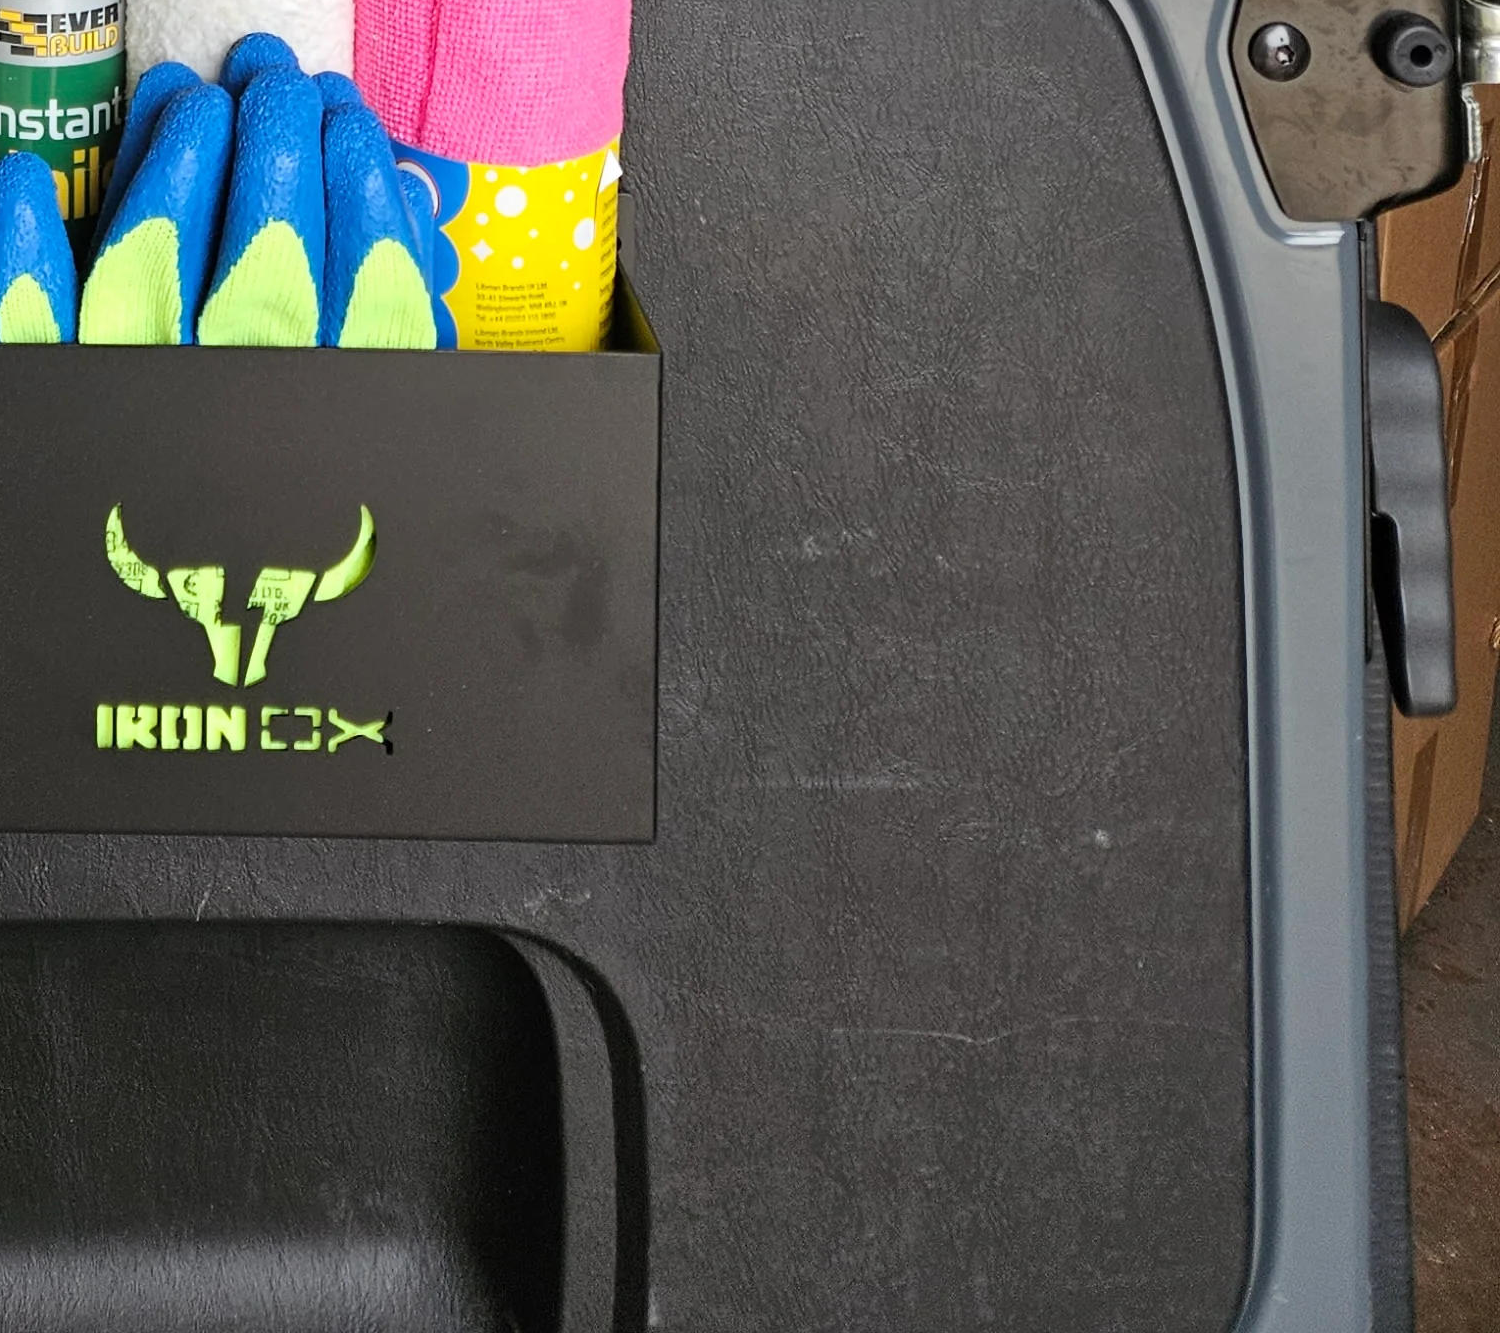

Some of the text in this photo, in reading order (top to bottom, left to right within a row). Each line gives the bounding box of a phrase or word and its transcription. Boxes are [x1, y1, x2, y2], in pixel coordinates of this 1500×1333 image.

[50, 2, 119, 34] EVER
[48, 24, 119, 58] BUILD
[96, 703, 393, 756] IRON OX
